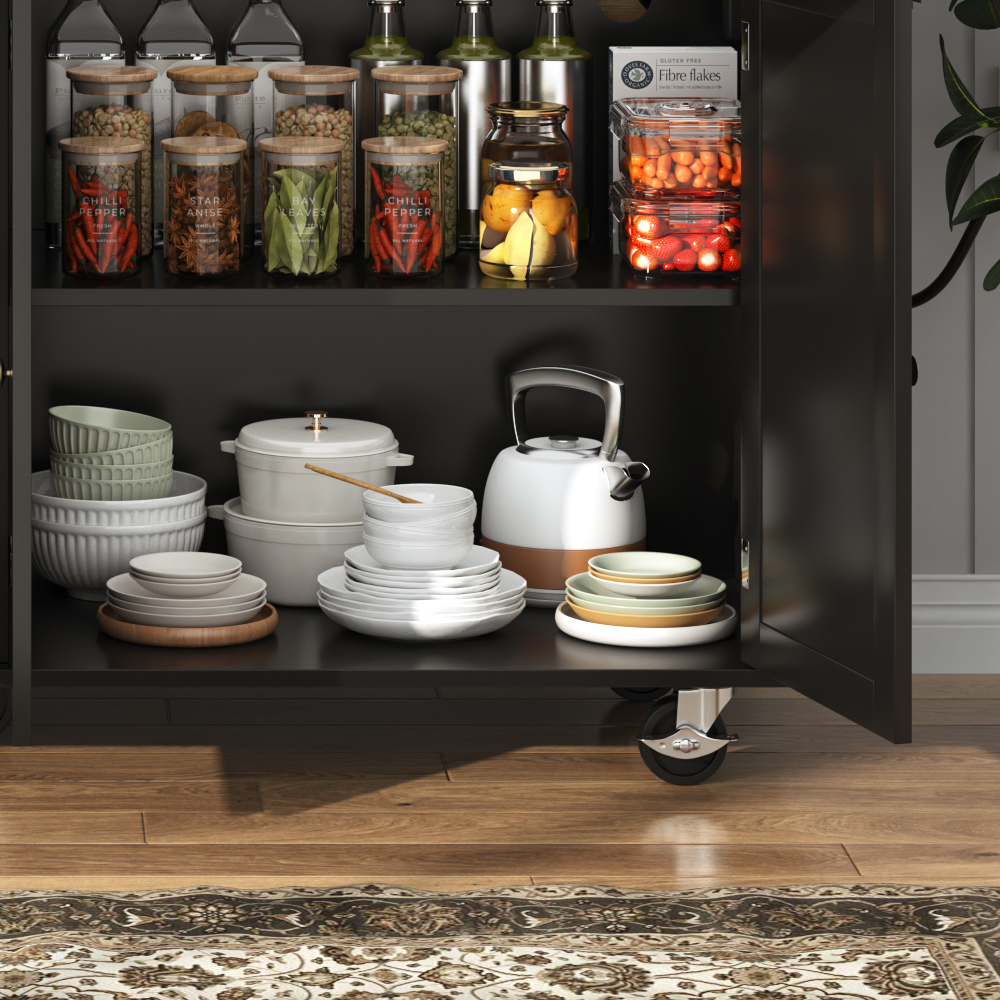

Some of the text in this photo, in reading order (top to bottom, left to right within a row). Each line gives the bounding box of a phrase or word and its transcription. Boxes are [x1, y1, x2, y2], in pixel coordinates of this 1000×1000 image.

[623, 62, 652, 78] DOVES FARM
[659, 68, 721, 81] Fibre flakes
[624, 78, 651, 89] ORGANIC
[83, 197, 121, 205] CHILLI
[191, 197, 220, 205] STAR
[292, 197, 316, 205] BAY
[388, 197, 427, 205] CHILLI
[80, 208, 125, 216] PEPPER
[187, 208, 223, 216] ANISE
[282, 208, 325, 216] LEAVES
[384, 208, 430, 216] PEPPER
